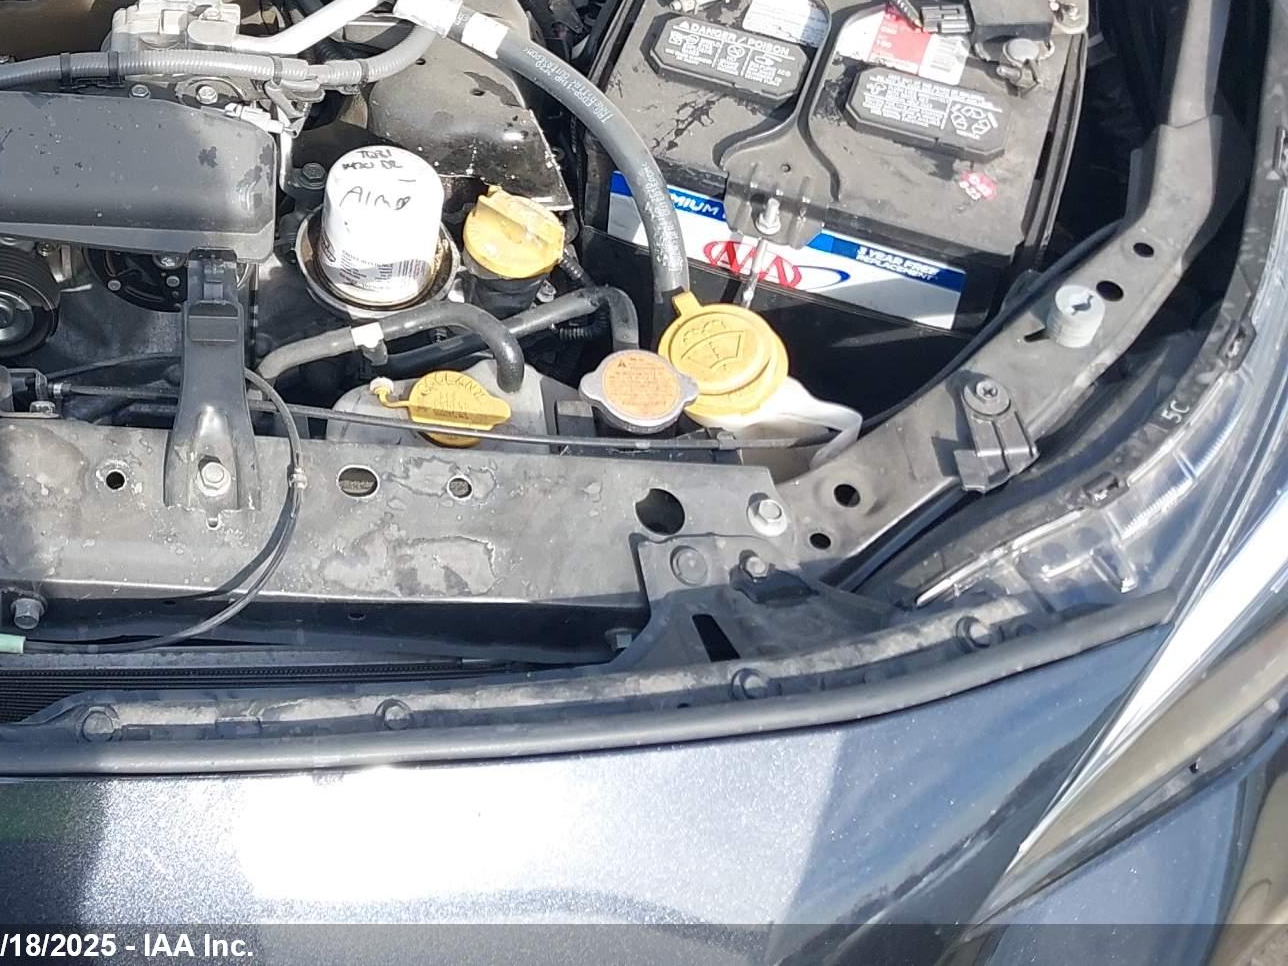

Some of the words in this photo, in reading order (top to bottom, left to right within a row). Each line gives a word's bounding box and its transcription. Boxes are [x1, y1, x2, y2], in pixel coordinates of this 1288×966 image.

[690, 24, 737, 42] DANGER
[747, 38, 791, 56] POISON
[857, 253, 938, 282] REPLACEMENT
[868, 248, 904, 266] YEAR
[904, 258, 940, 274] FREE
[1161, 400, 1190, 424] 5C
